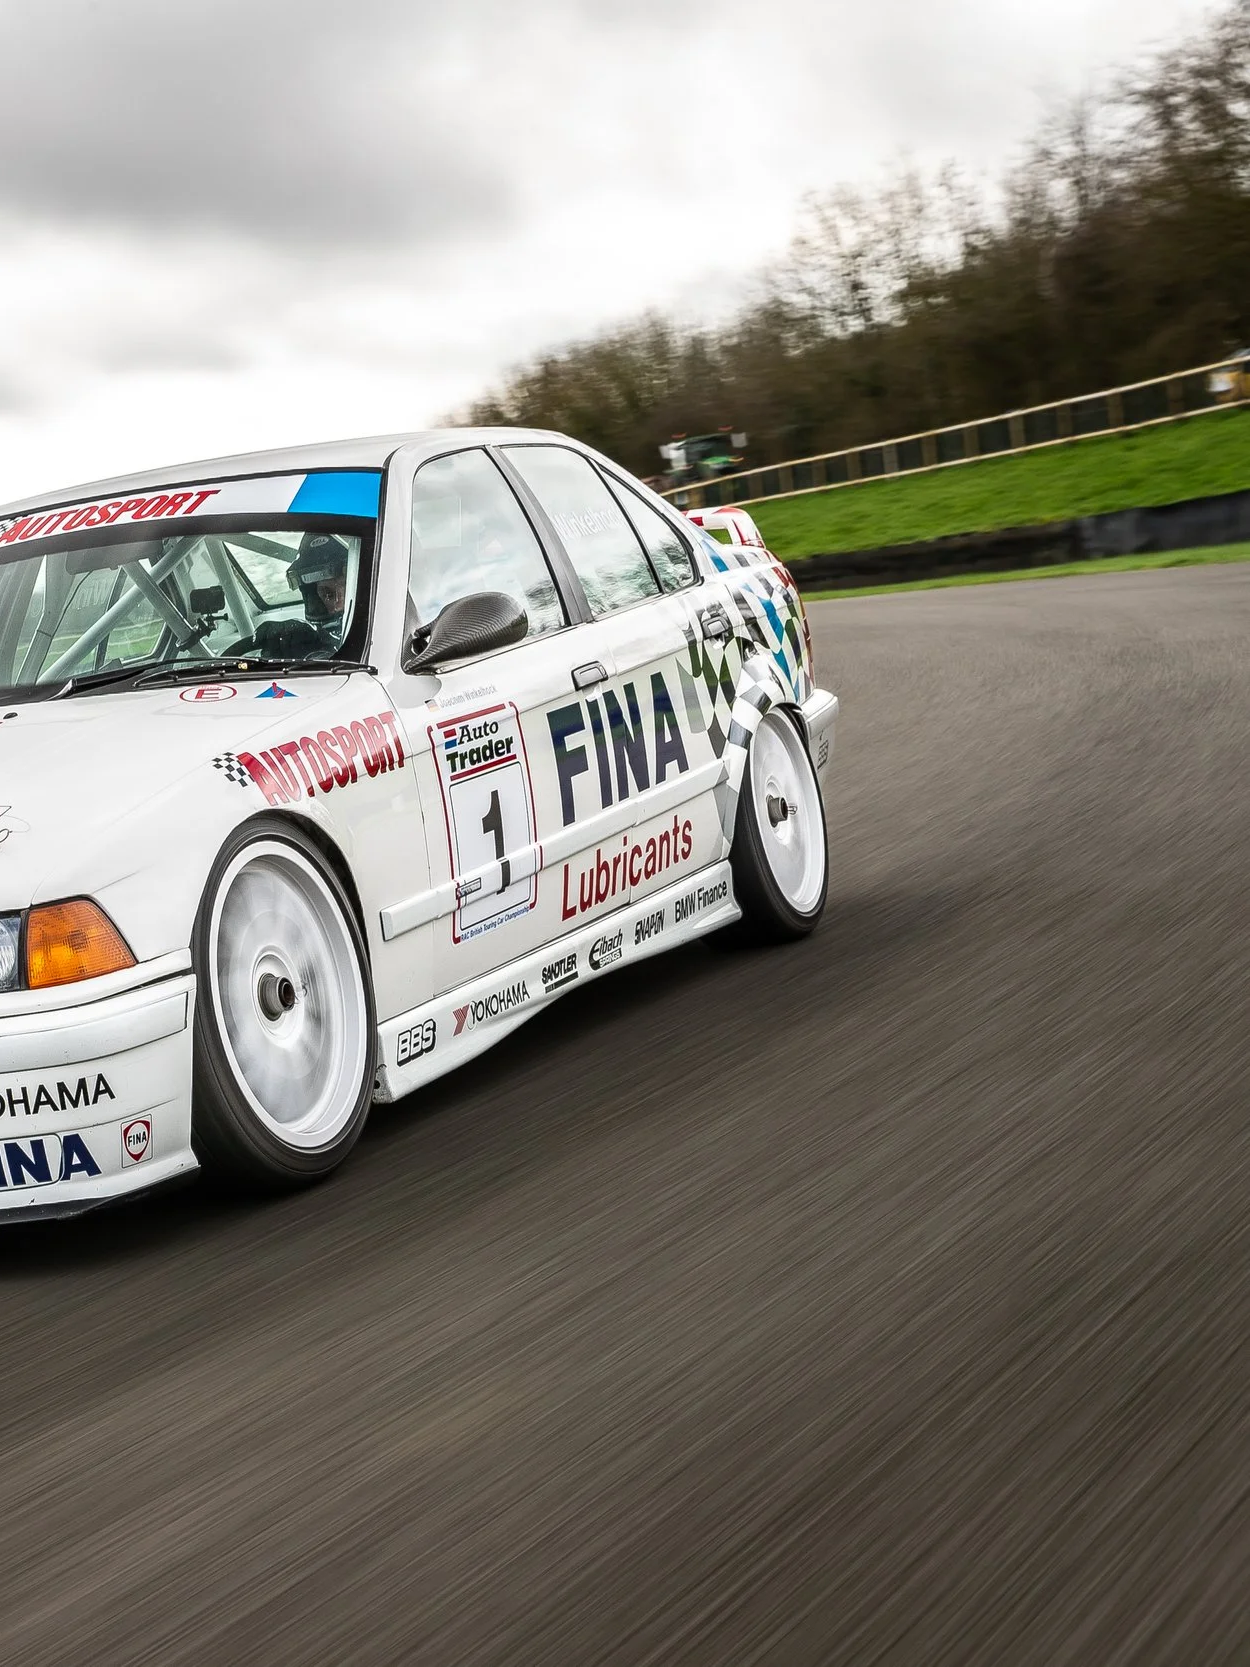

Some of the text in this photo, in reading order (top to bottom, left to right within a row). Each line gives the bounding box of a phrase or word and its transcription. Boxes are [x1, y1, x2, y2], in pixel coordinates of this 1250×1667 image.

[446, 735, 514, 773] Trader
[458, 721, 499, 745] Auto
[546, 671, 690, 828] FINA
[237, 710, 405, 805] AUTOSPORT
[482, 789, 510, 895] 1
[561, 814, 692, 921] Lubricants
[675, 880, 728, 923] BMW Finance
[541, 953, 578, 985] SANDTLER
[589, 928, 623, 971] Eibach
[470, 980, 531, 1024] YOKOHAMA
[397, 1018, 437, 1067] BBS
[127, 1130, 147, 1147] FINA
